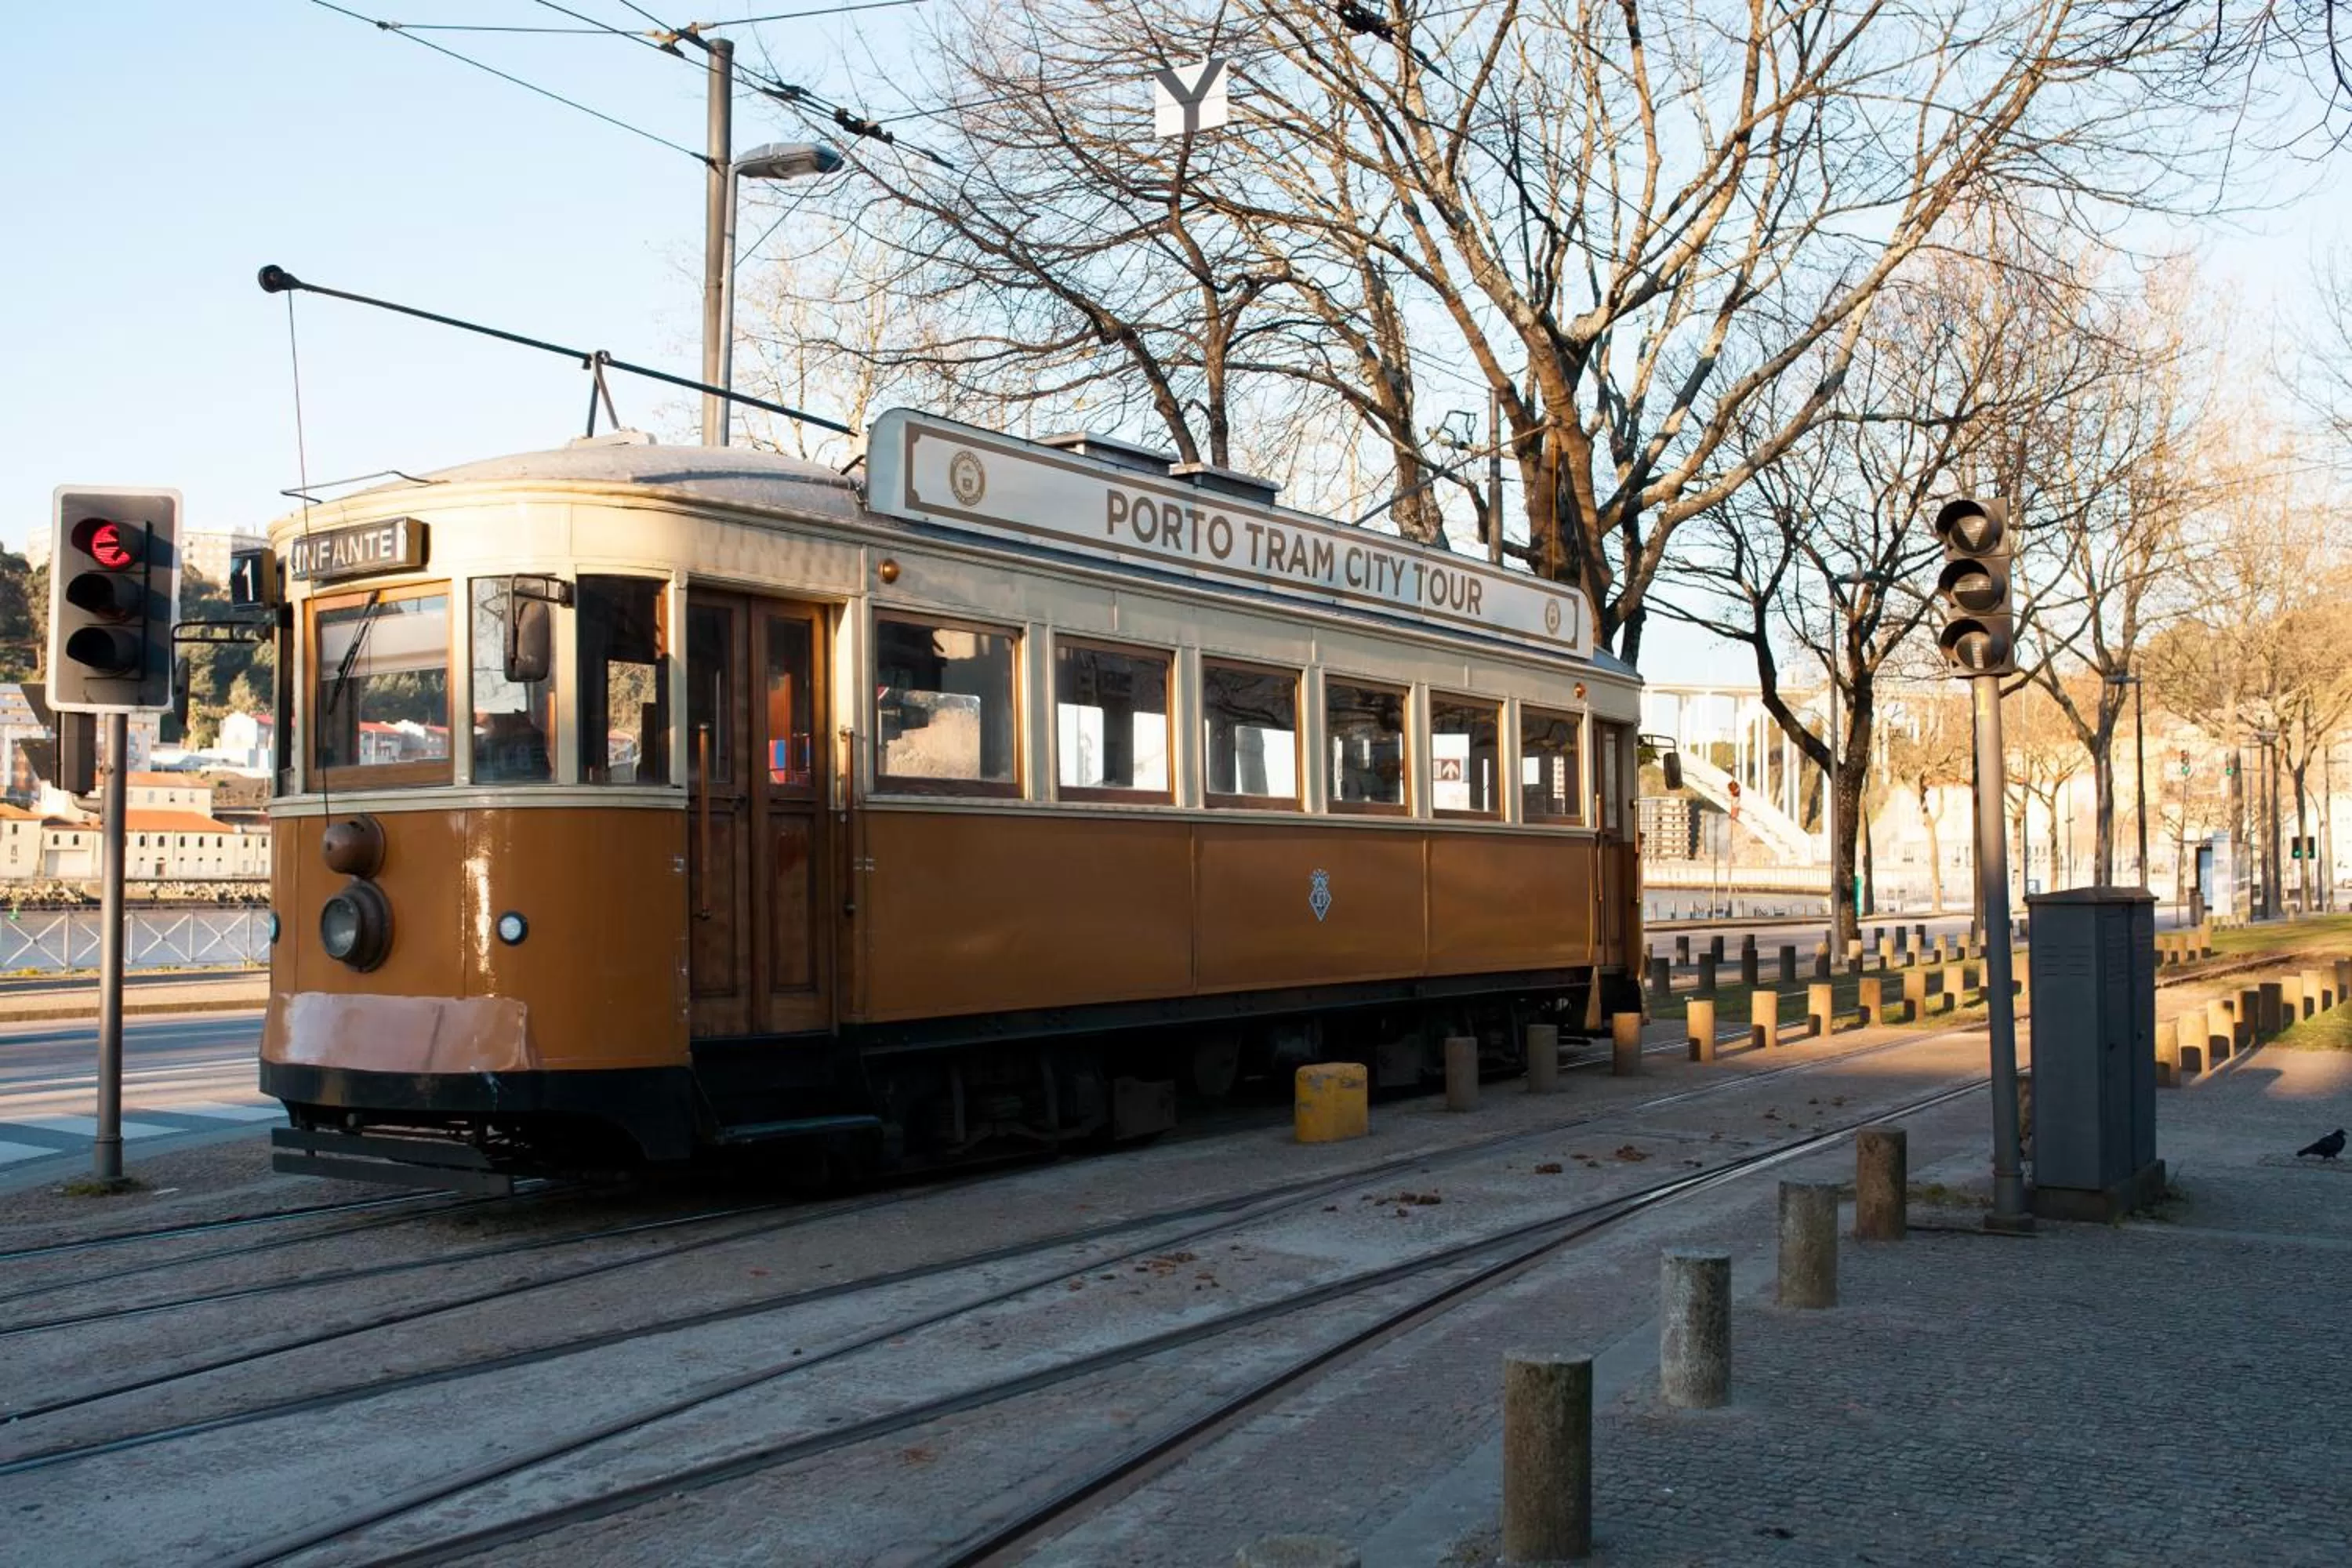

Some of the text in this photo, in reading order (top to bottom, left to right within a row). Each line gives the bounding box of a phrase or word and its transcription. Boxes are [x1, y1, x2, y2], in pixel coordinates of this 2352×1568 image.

[1155, 58, 1227, 133] Y
[241, 558, 254, 602] 1
[295, 528, 392, 573] INFANTE
[1106, 488, 1483, 615] PORTO TRAM CITY TOUR
